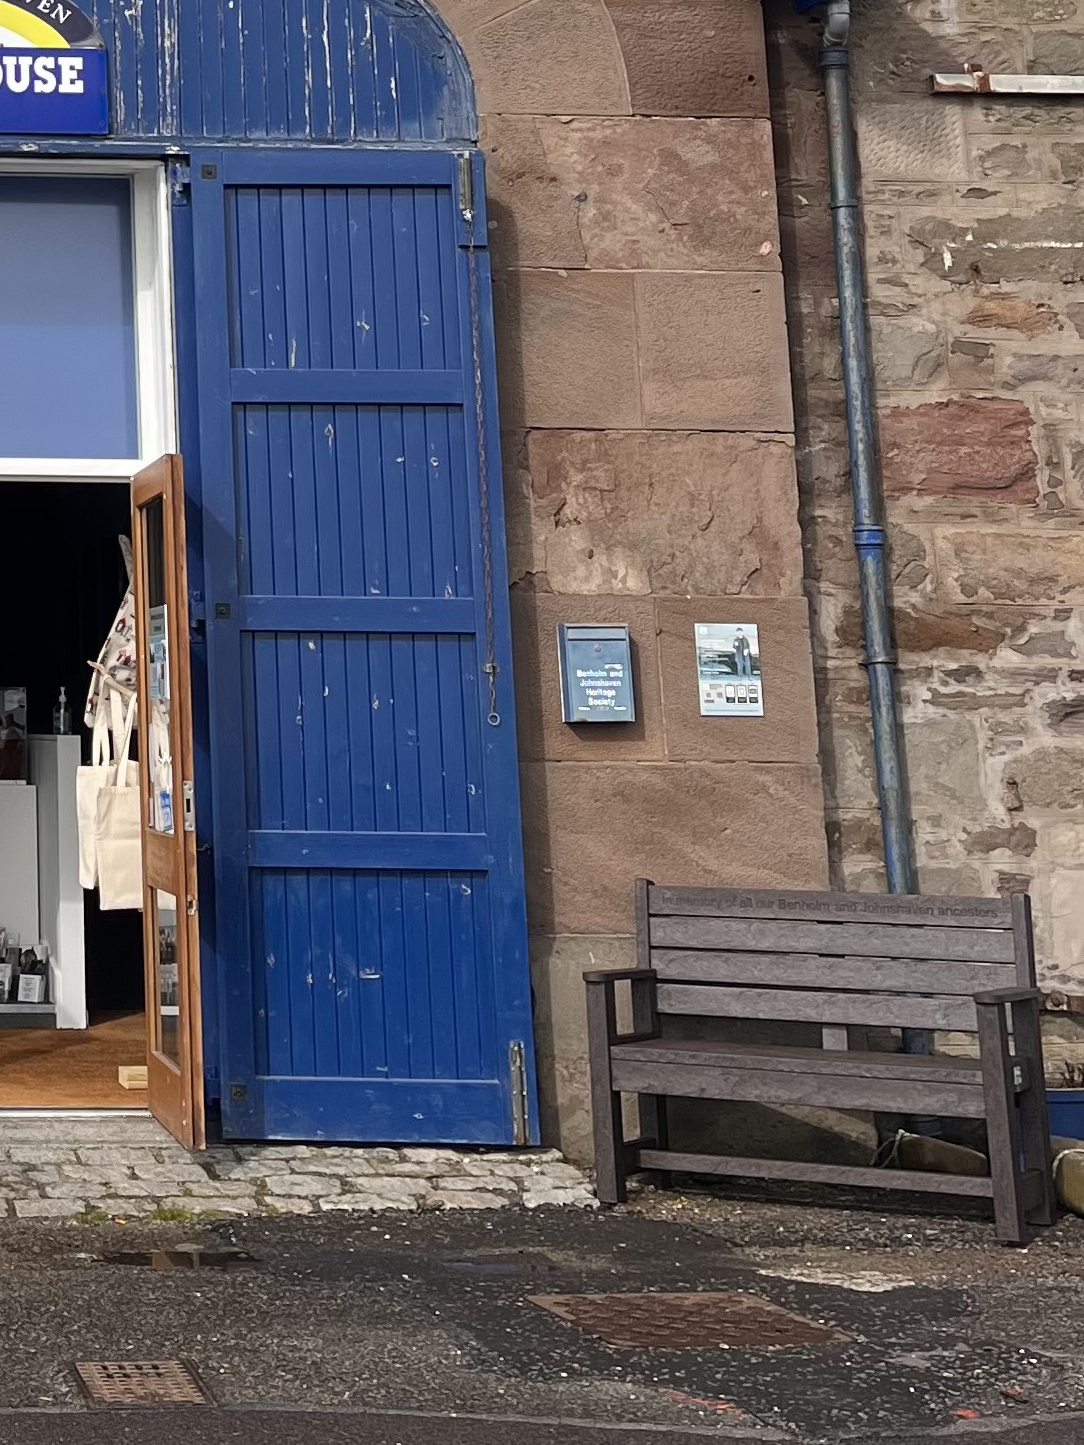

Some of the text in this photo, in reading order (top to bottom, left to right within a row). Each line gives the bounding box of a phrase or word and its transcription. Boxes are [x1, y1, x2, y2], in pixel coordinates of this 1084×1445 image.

[609, 669, 623, 677] and
[585, 688, 617, 698] Heritage
[587, 697, 616, 707] Society
[661, 895, 671, 905] In
[726, 896, 737, 908] of
[739, 896, 753, 909] all
[757, 900, 775, 909] our
[777, 898, 830, 912] Benholm
[835, 902, 858, 913] and
[861, 903, 934, 917] Johnshaven
[937, 905, 999, 918] ancestors
